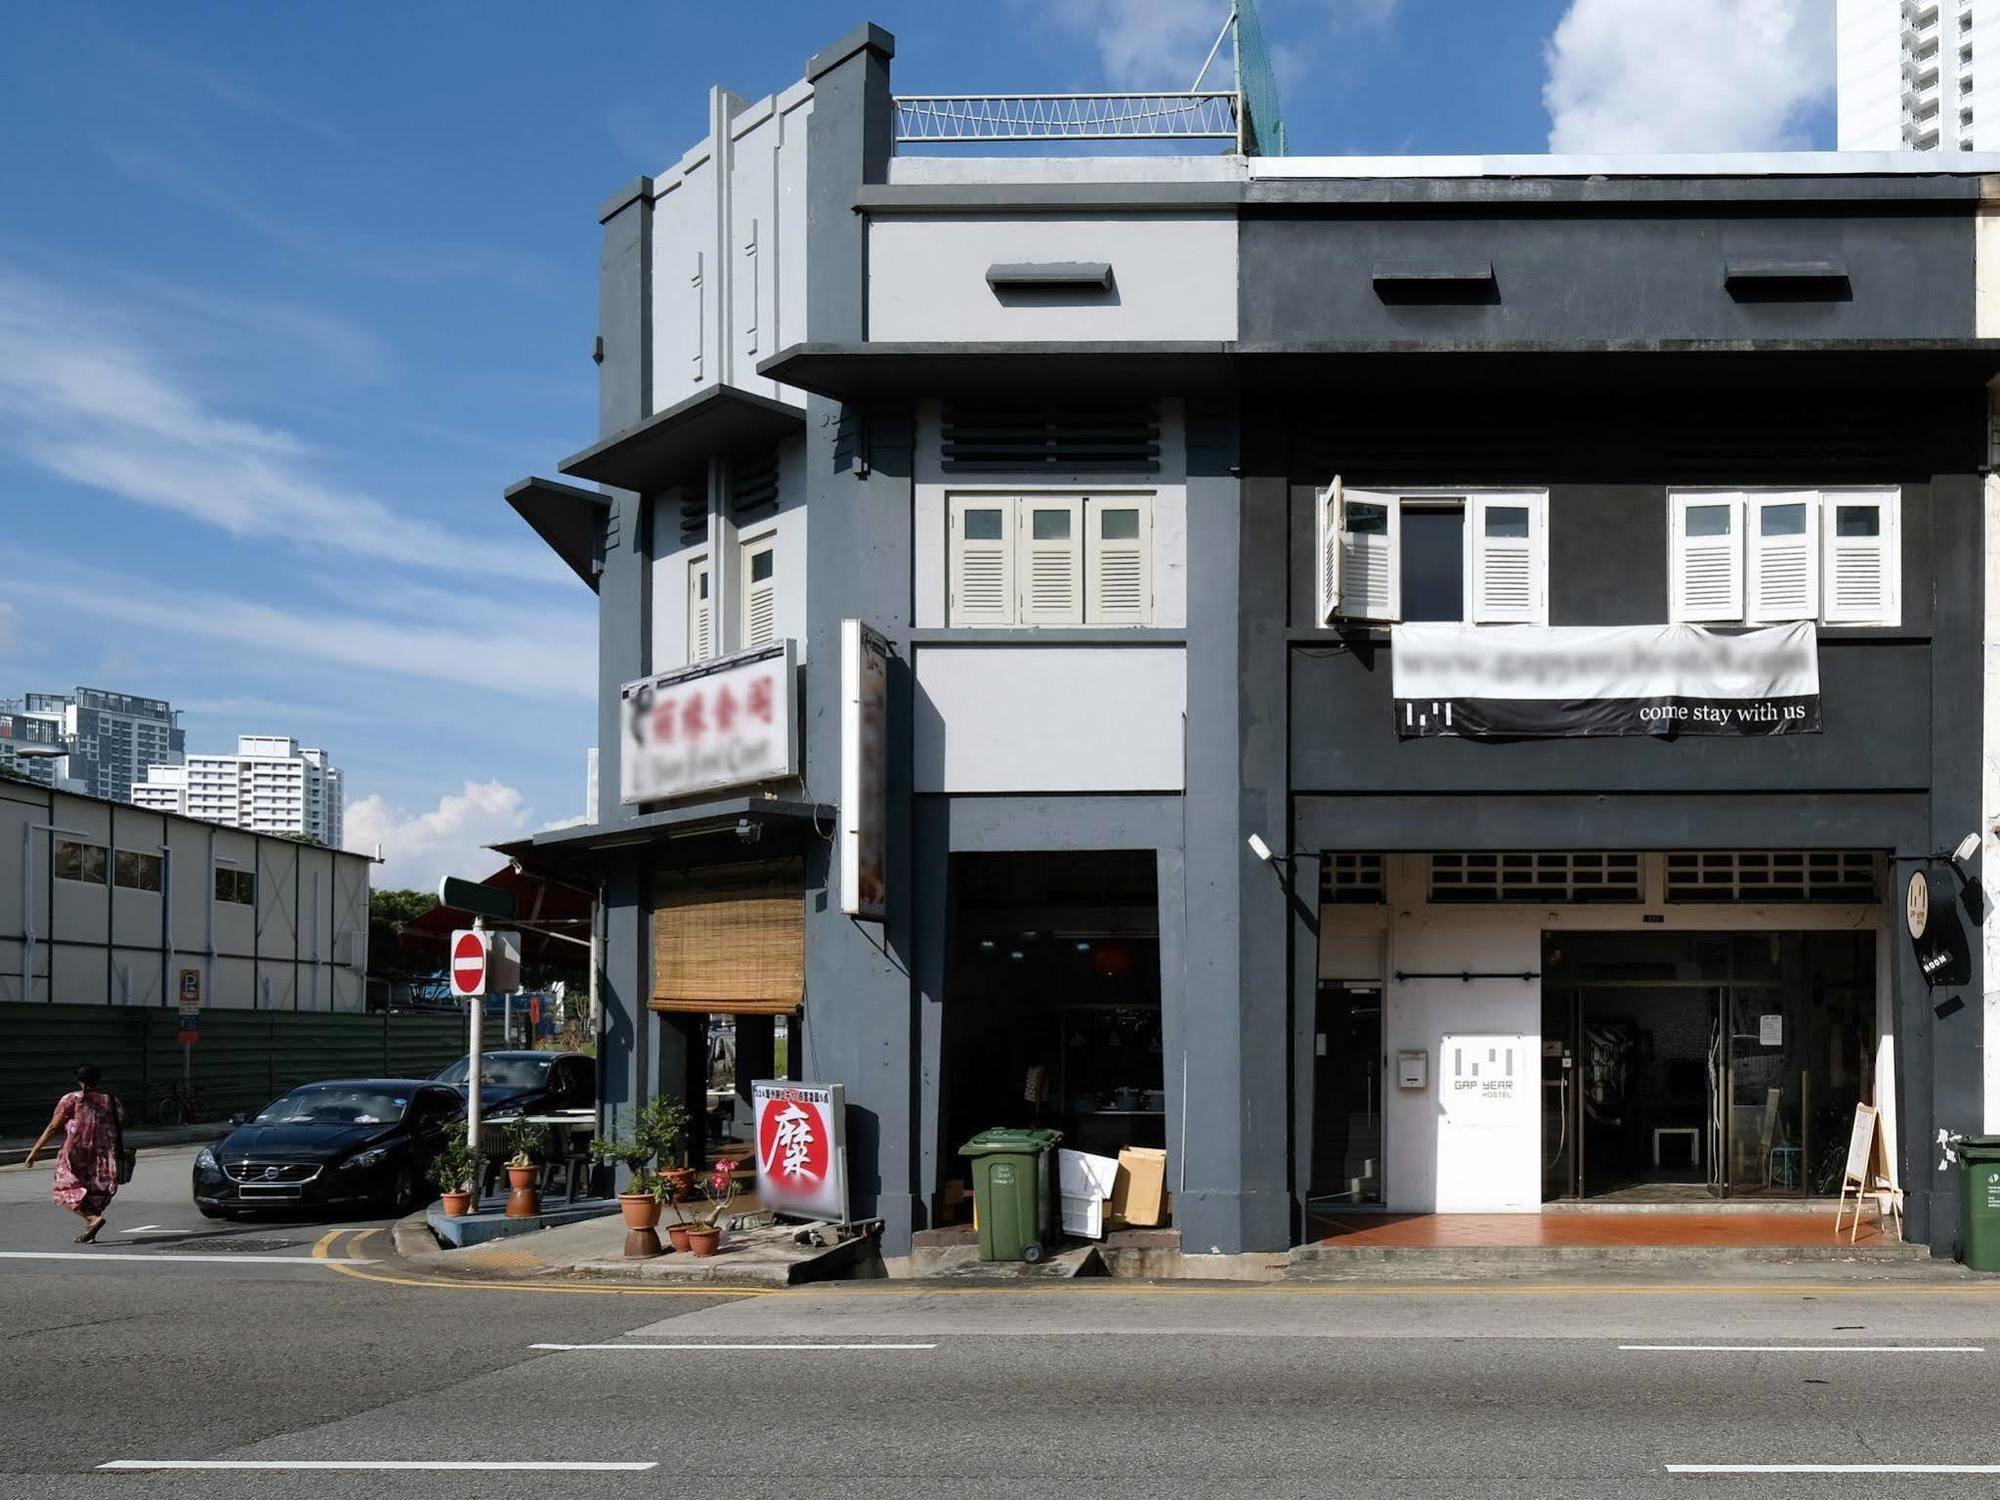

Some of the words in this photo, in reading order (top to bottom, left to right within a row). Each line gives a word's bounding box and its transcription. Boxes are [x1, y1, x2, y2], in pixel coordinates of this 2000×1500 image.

[1639, 705, 1688, 720] come
[1692, 705, 1732, 725] stay
[1737, 702, 1778, 721] with
[1783, 705, 1805, 719] us
[1454, 1080, 1477, 1090] GAP
[1482, 1080, 1513, 1090] YEAR
